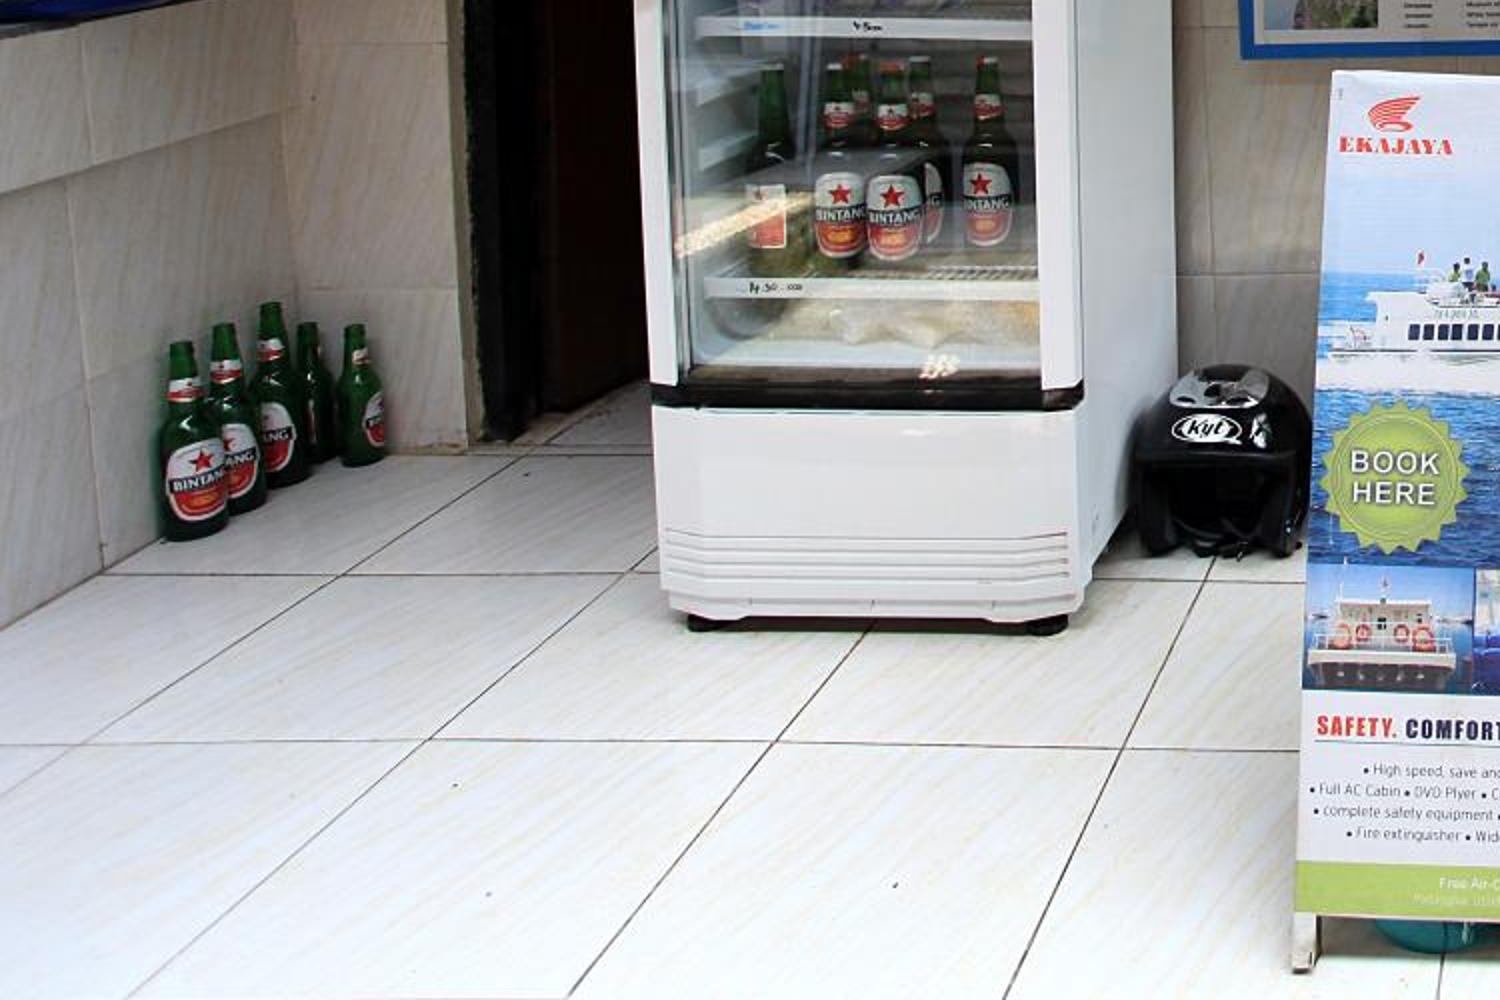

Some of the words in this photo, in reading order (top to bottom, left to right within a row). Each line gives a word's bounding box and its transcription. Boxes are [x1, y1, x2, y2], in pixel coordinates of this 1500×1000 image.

[1339, 136, 1453, 155] EKAJAYA
[1350, 450, 1440, 475] BOOK
[173, 469, 224, 491] BINTAN
[1352, 481, 1435, 506] HERE
[1317, 716, 1398, 739] SAFETY.
[1374, 766, 1401, 779] High
[1450, 769, 1477, 780] save
